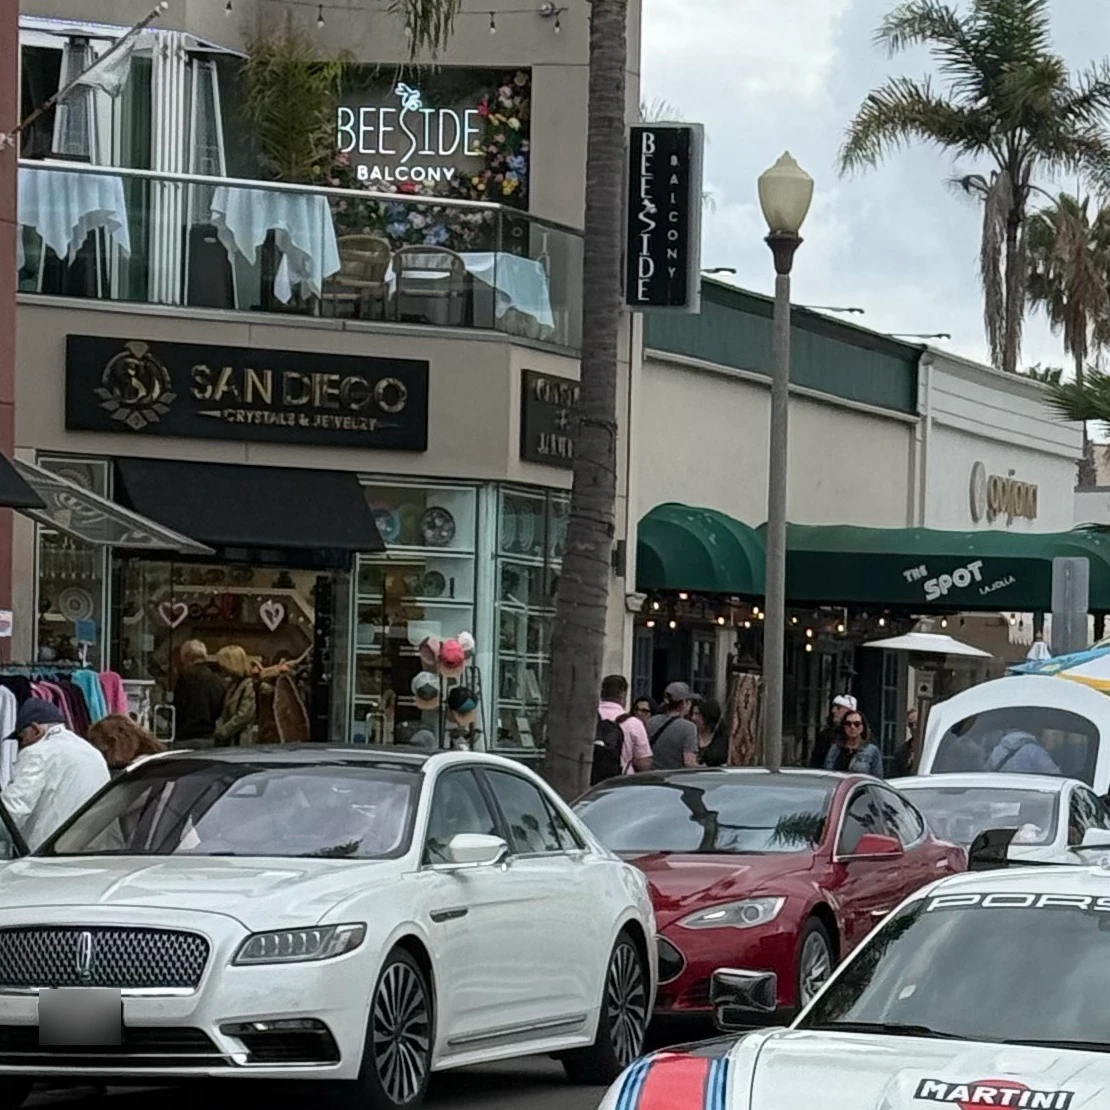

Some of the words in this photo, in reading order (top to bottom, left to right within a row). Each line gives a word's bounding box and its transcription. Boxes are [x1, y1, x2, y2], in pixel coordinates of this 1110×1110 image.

[337, 106, 485, 163] BEESIDE
[357, 165, 455, 181] BALCONY
[637, 132, 657, 301] BEESIDE
[666, 155, 679, 279] BALCONY
[190, 364, 273, 404] SAN
[283, 371, 407, 413] DIEGO
[223, 408, 296, 426] CRYSTALS
[299, 414, 310, 426] &
[313, 414, 377, 431] JEWELRY
[903, 565, 928, 583] THE
[923, 560, 983, 601] SPOT
[978, 585, 991, 595] LA
[991, 575, 1016, 593] JOLLA
[919, 1081, 1068, 1110] MARTINI
